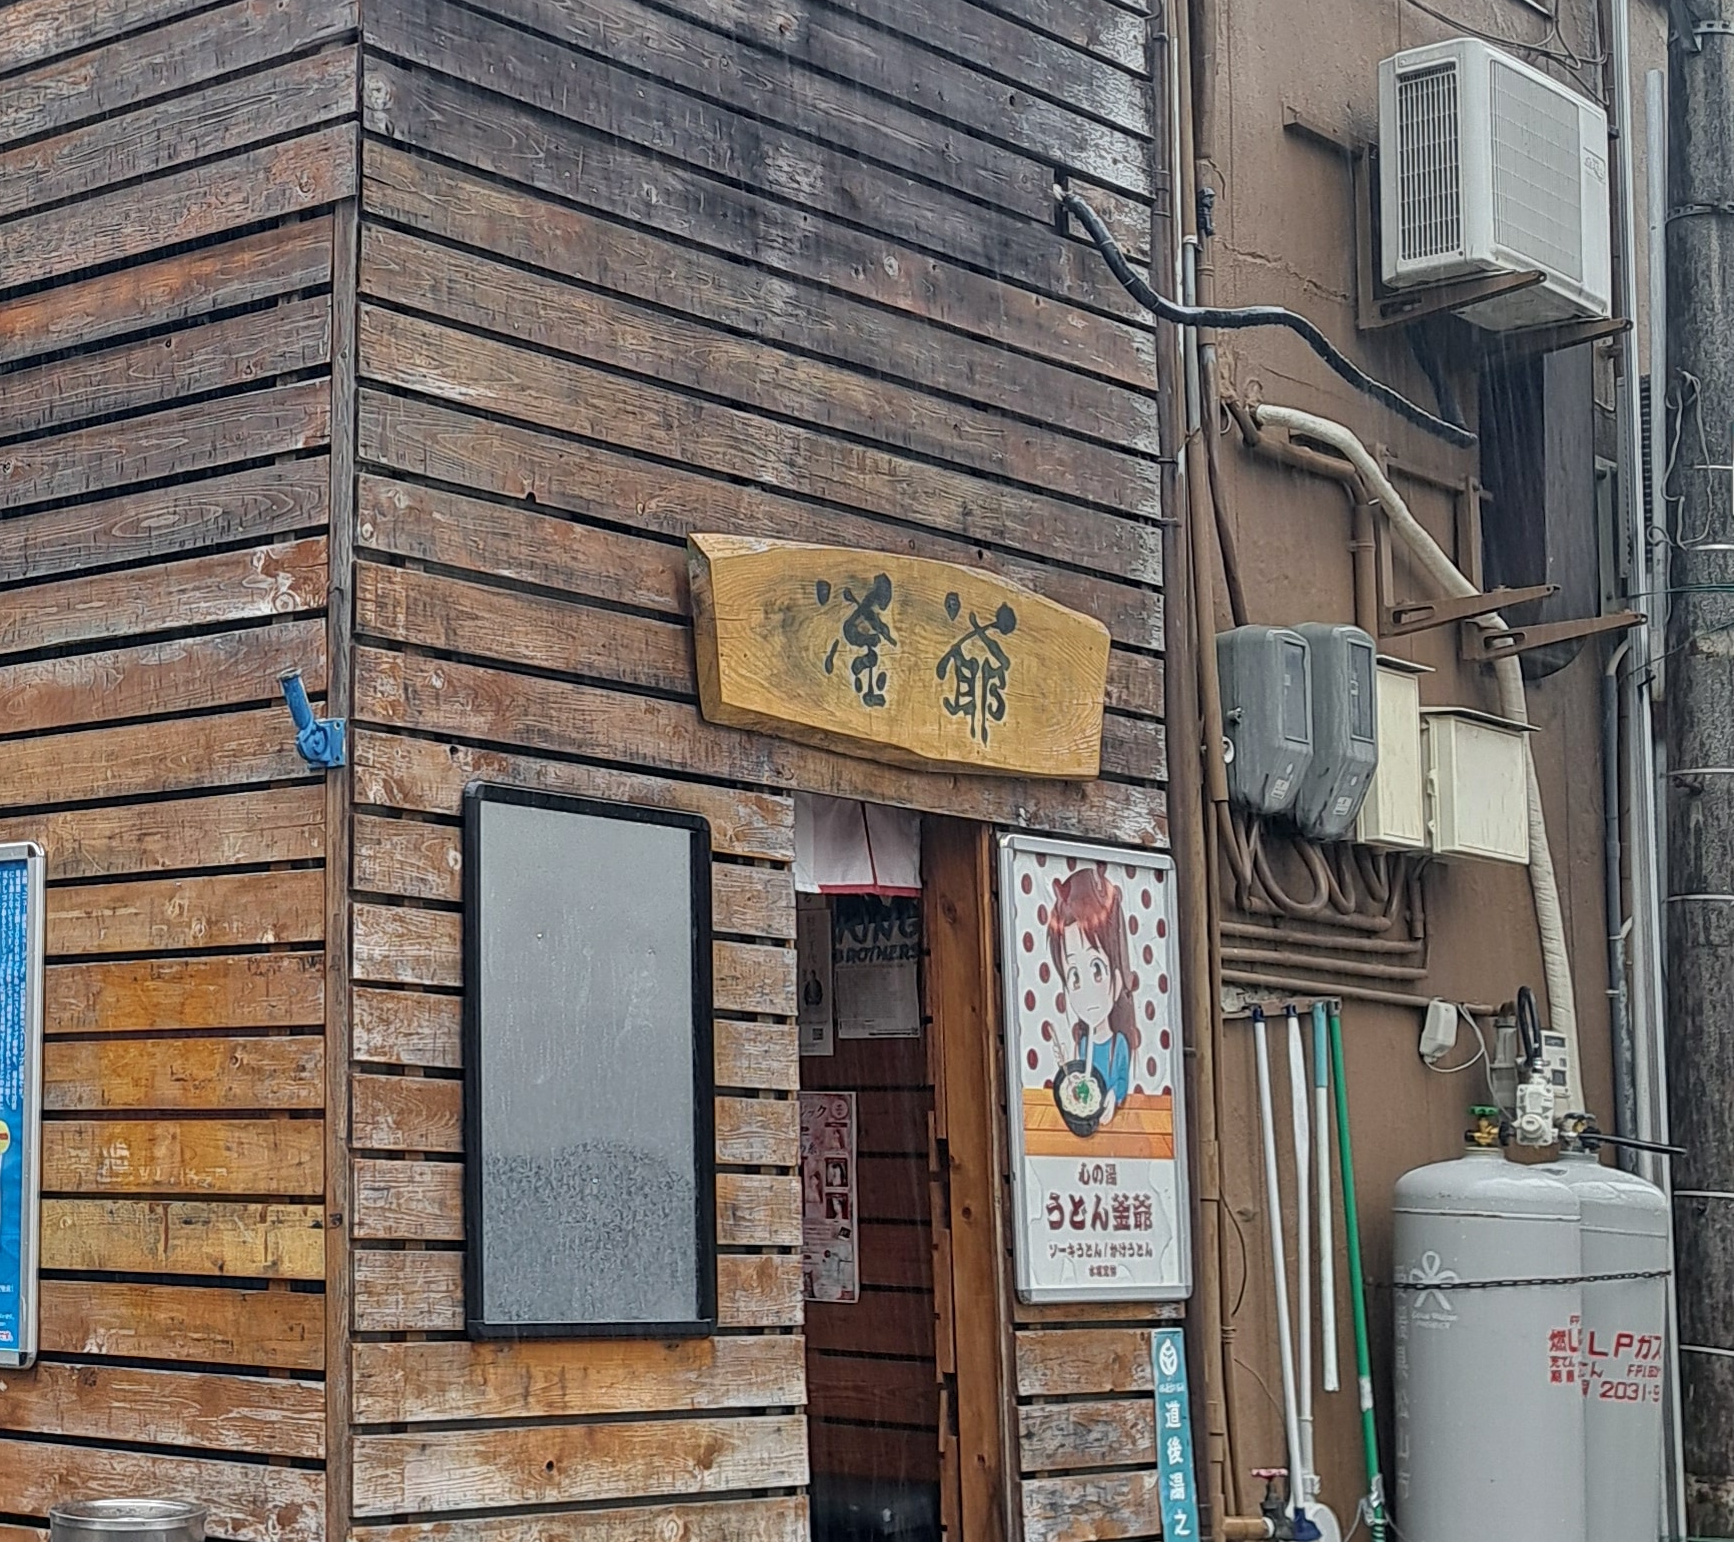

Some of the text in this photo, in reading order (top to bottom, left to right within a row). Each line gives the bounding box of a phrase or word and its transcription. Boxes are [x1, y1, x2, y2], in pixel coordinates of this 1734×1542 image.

[1045, 1192, 1153, 1232] うどん釜爺
